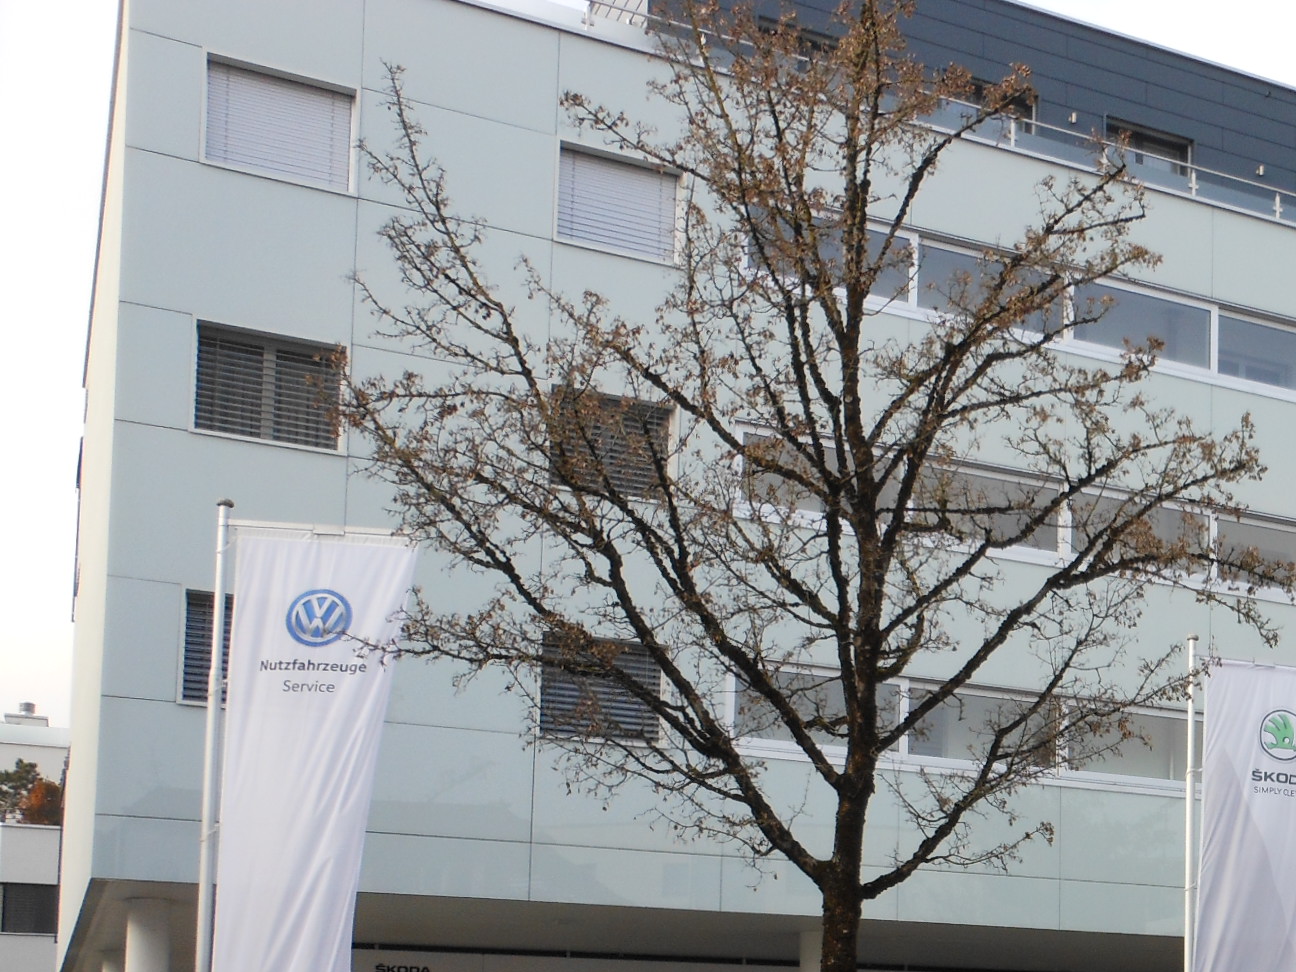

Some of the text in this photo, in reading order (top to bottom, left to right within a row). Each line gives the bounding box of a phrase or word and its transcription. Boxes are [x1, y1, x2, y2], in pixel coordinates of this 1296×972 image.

[259, 658, 368, 675] Nutzfahrzeuge
[282, 679, 336, 693] Service
[1253, 786, 1281, 795] SIMPLY
